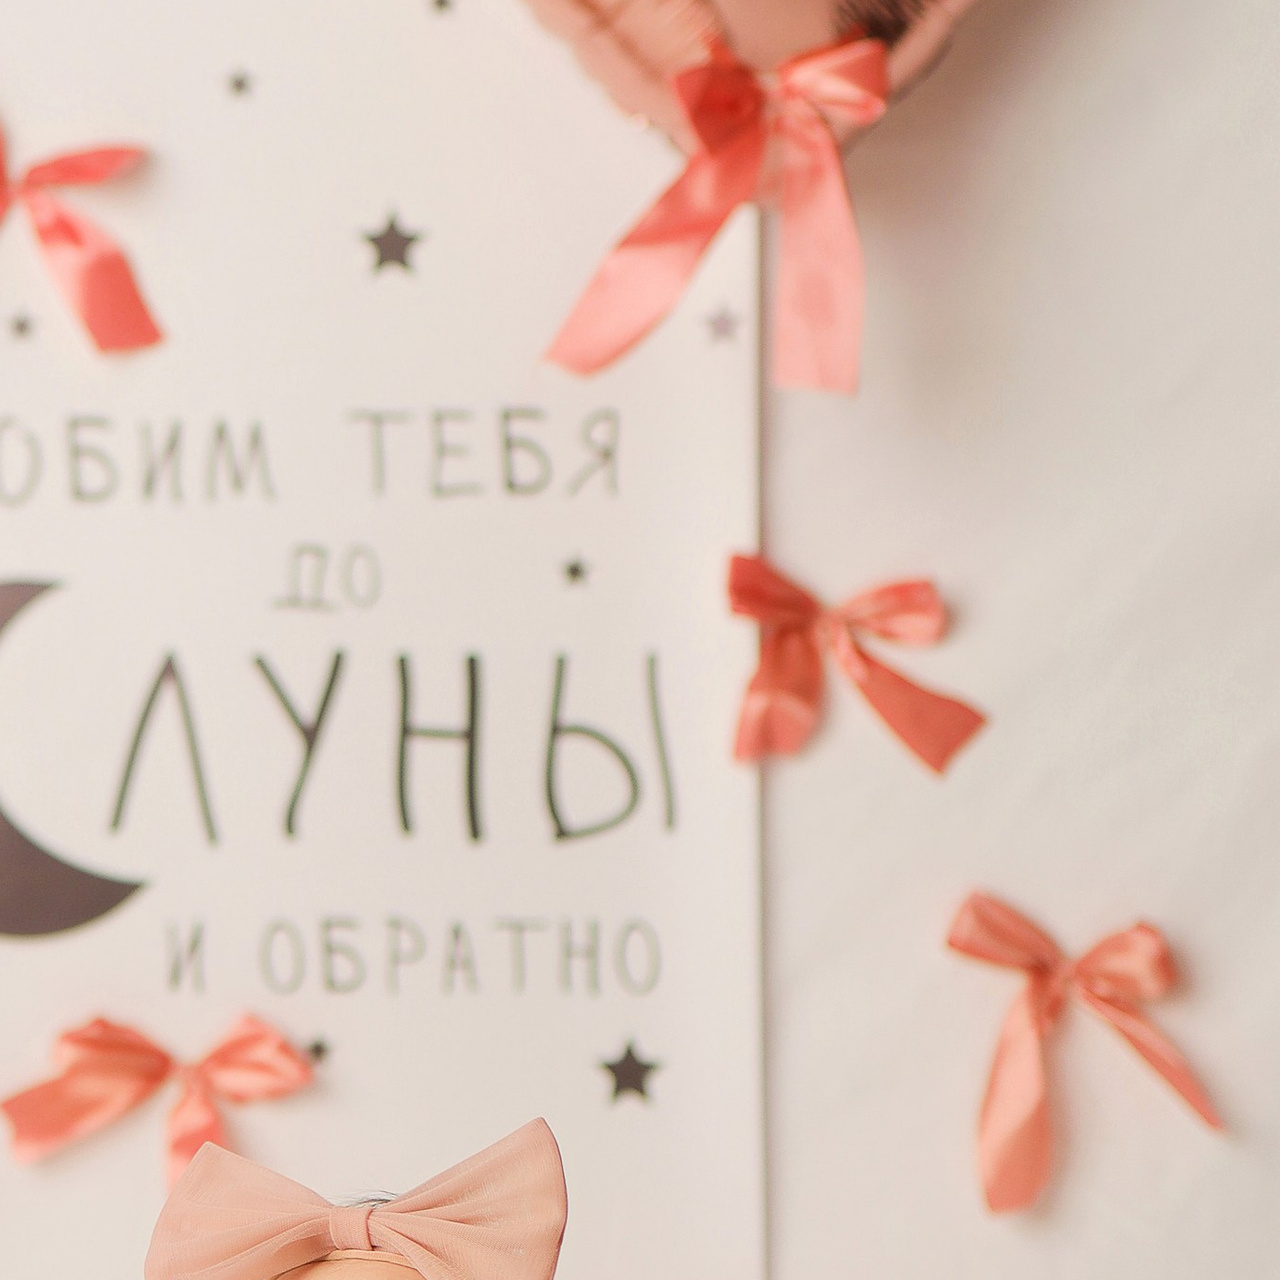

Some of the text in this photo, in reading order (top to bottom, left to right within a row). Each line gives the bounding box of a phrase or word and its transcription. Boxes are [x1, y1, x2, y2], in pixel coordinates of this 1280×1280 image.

[347, 408, 621, 500] ТЕБЯ
[272, 543, 382, 611] ДО
[108, 650, 676, 843] ЛУНЫ
[166, 919, 663, 996] И ОБРАТНО
